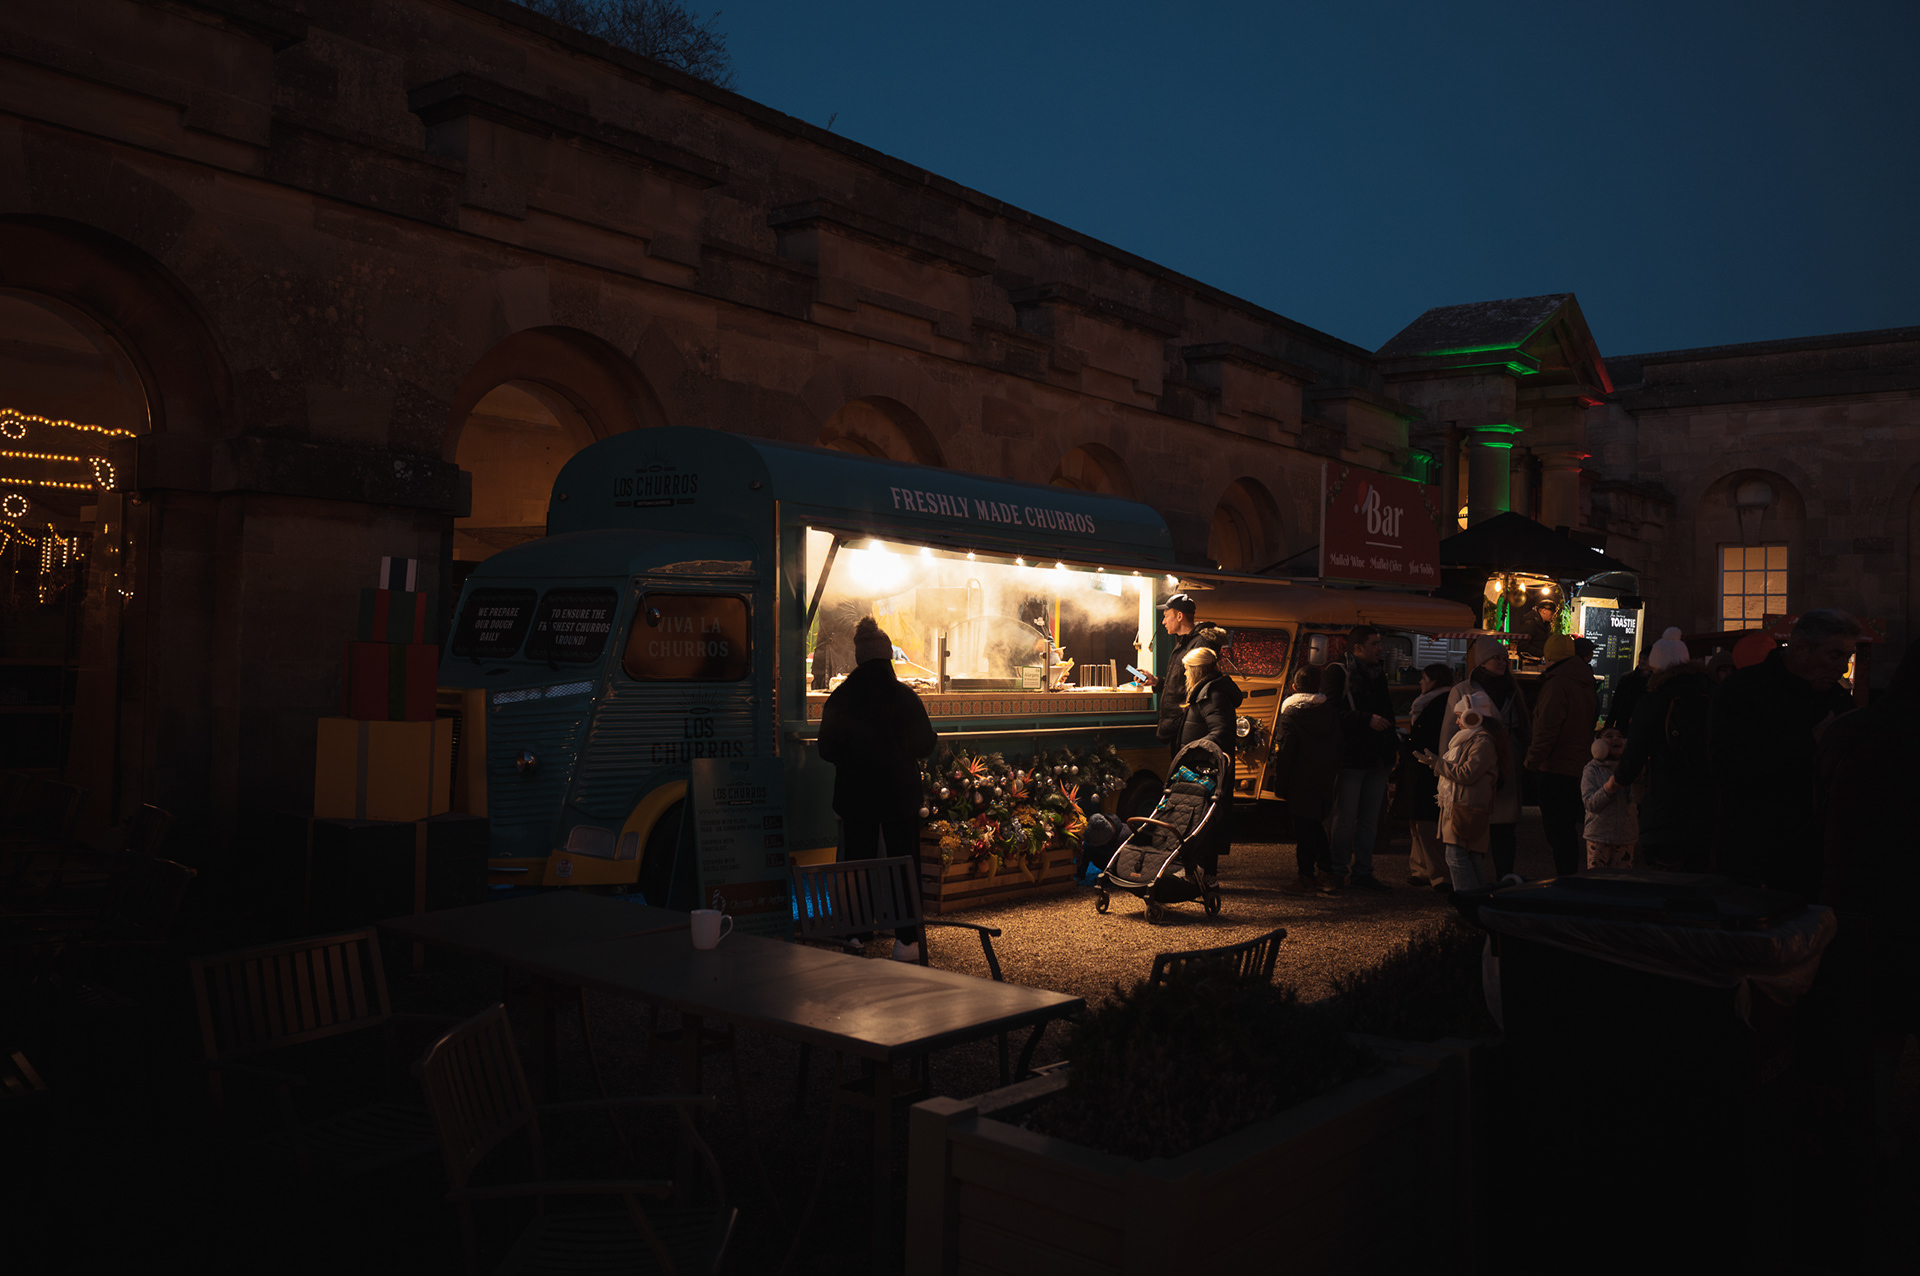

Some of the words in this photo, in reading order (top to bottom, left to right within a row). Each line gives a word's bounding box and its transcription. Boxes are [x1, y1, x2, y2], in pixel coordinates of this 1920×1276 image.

[613, 477, 633, 498] LOS
[636, 473, 698, 496] CHURROS
[889, 486, 970, 519] FRESHLY
[973, 499, 1023, 525] MADE
[1024, 506, 1096, 534] CHURROS
[1366, 489, 1404, 538] Bar
[1329, 552, 1349, 567] Mulled
[1369, 555, 1390, 572] Mulled
[478, 607, 489, 616] WE
[489, 607, 520, 617] PREPARE
[551, 608, 561, 618] TO
[561, 608, 590, 619] ENSURE
[591, 609, 607, 620] THE
[475, 619, 489, 629] OUR
[489, 619, 514, 630] DOUGH
[537, 621, 575, 632] FRSHEST
[575, 622, 611, 634] CHURROS
[656, 616, 695, 633] VIVA
[701, 616, 722, 633] LA
[1610, 617, 1636, 628] TOASTIE
[479, 632, 501, 642] DAILY
[648, 640, 729, 658] CHURROS
[683, 717, 715, 739] LOS
[651, 740, 744, 765] CHURROS
[712, 787, 727, 800] LOS
[728, 786, 767, 800] CHURROS
